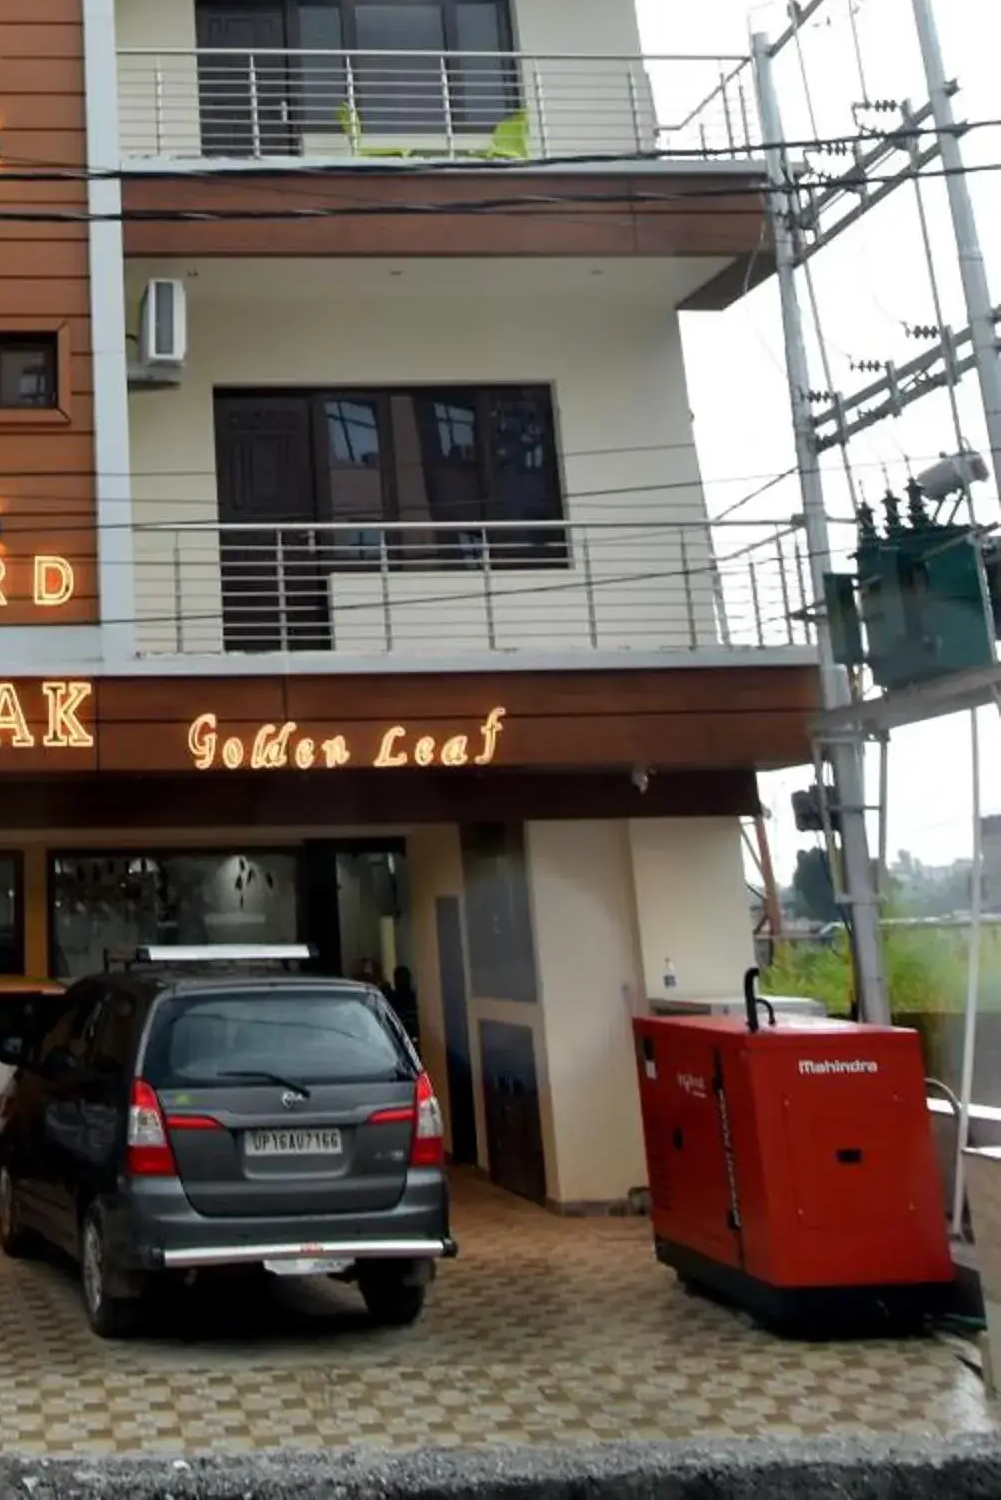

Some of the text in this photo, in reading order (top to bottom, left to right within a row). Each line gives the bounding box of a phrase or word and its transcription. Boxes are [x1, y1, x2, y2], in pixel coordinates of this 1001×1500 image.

[188, 707, 506, 769] Golden Leaf
[798, 1059, 878, 1075] Mahindra
